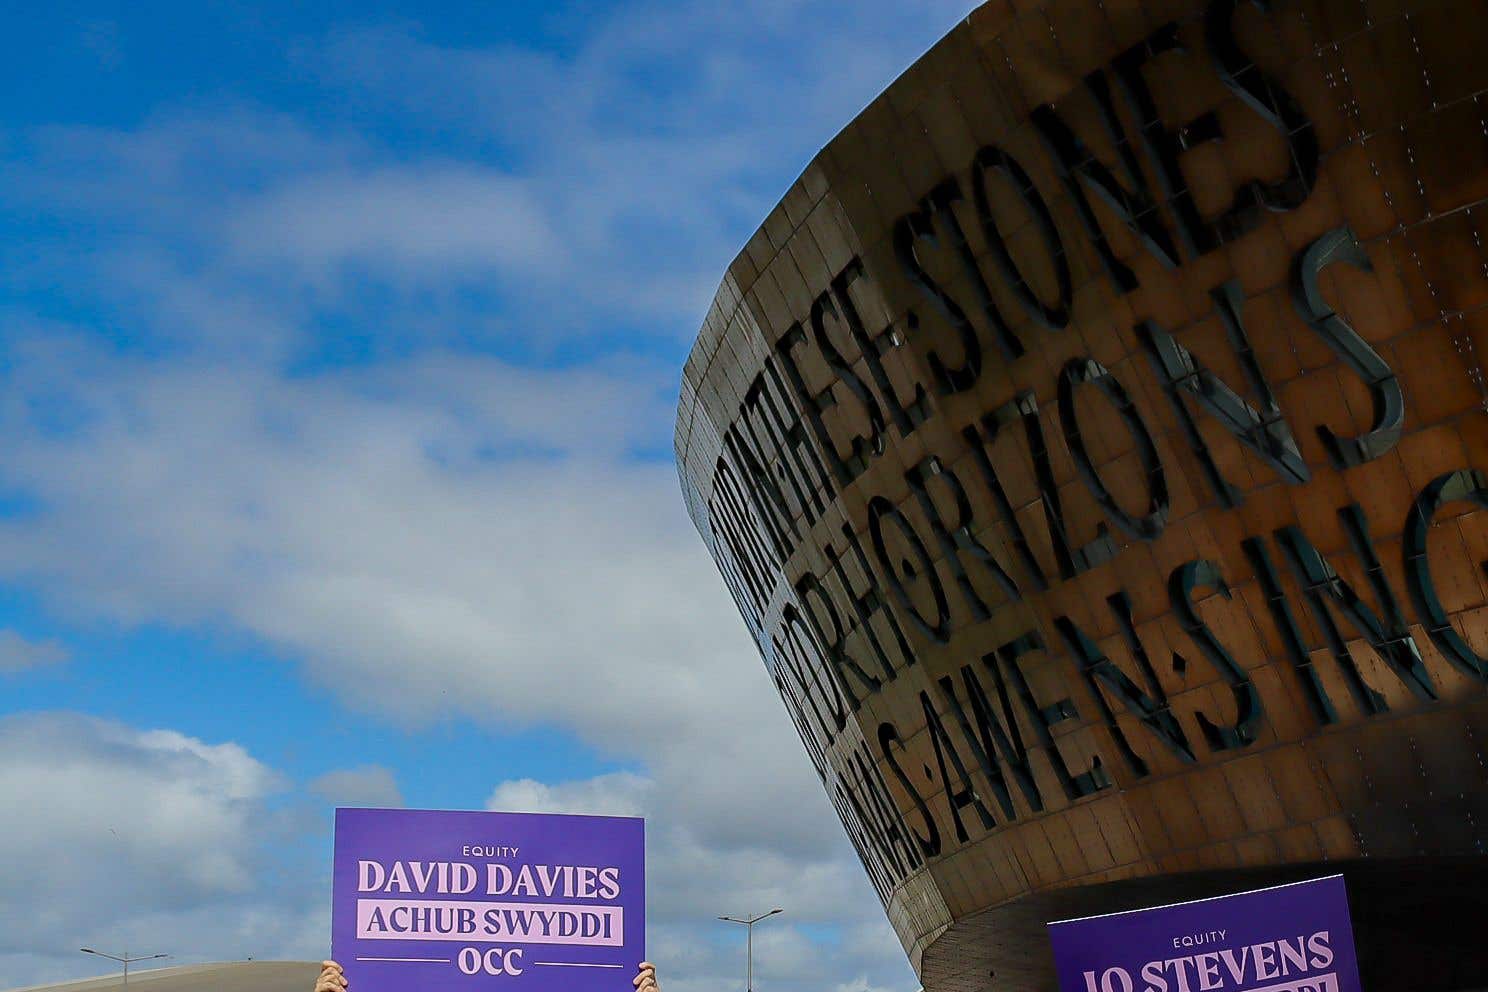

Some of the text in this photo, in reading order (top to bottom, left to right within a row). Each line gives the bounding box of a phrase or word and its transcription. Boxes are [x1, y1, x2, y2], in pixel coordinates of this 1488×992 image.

[893, 0, 1320, 394] STONES
[824, 224, 1404, 681] HORIZONS
[920, 592, 1196, 845] AWEN
[463, 845, 519, 858] EQUITY
[357, 860, 620, 899] DAVID DAVIES
[366, 906, 611, 939] ACHUB SWYDDI
[1172, 929, 1227, 949] EQUITY
[457, 947, 523, 976] OCC
